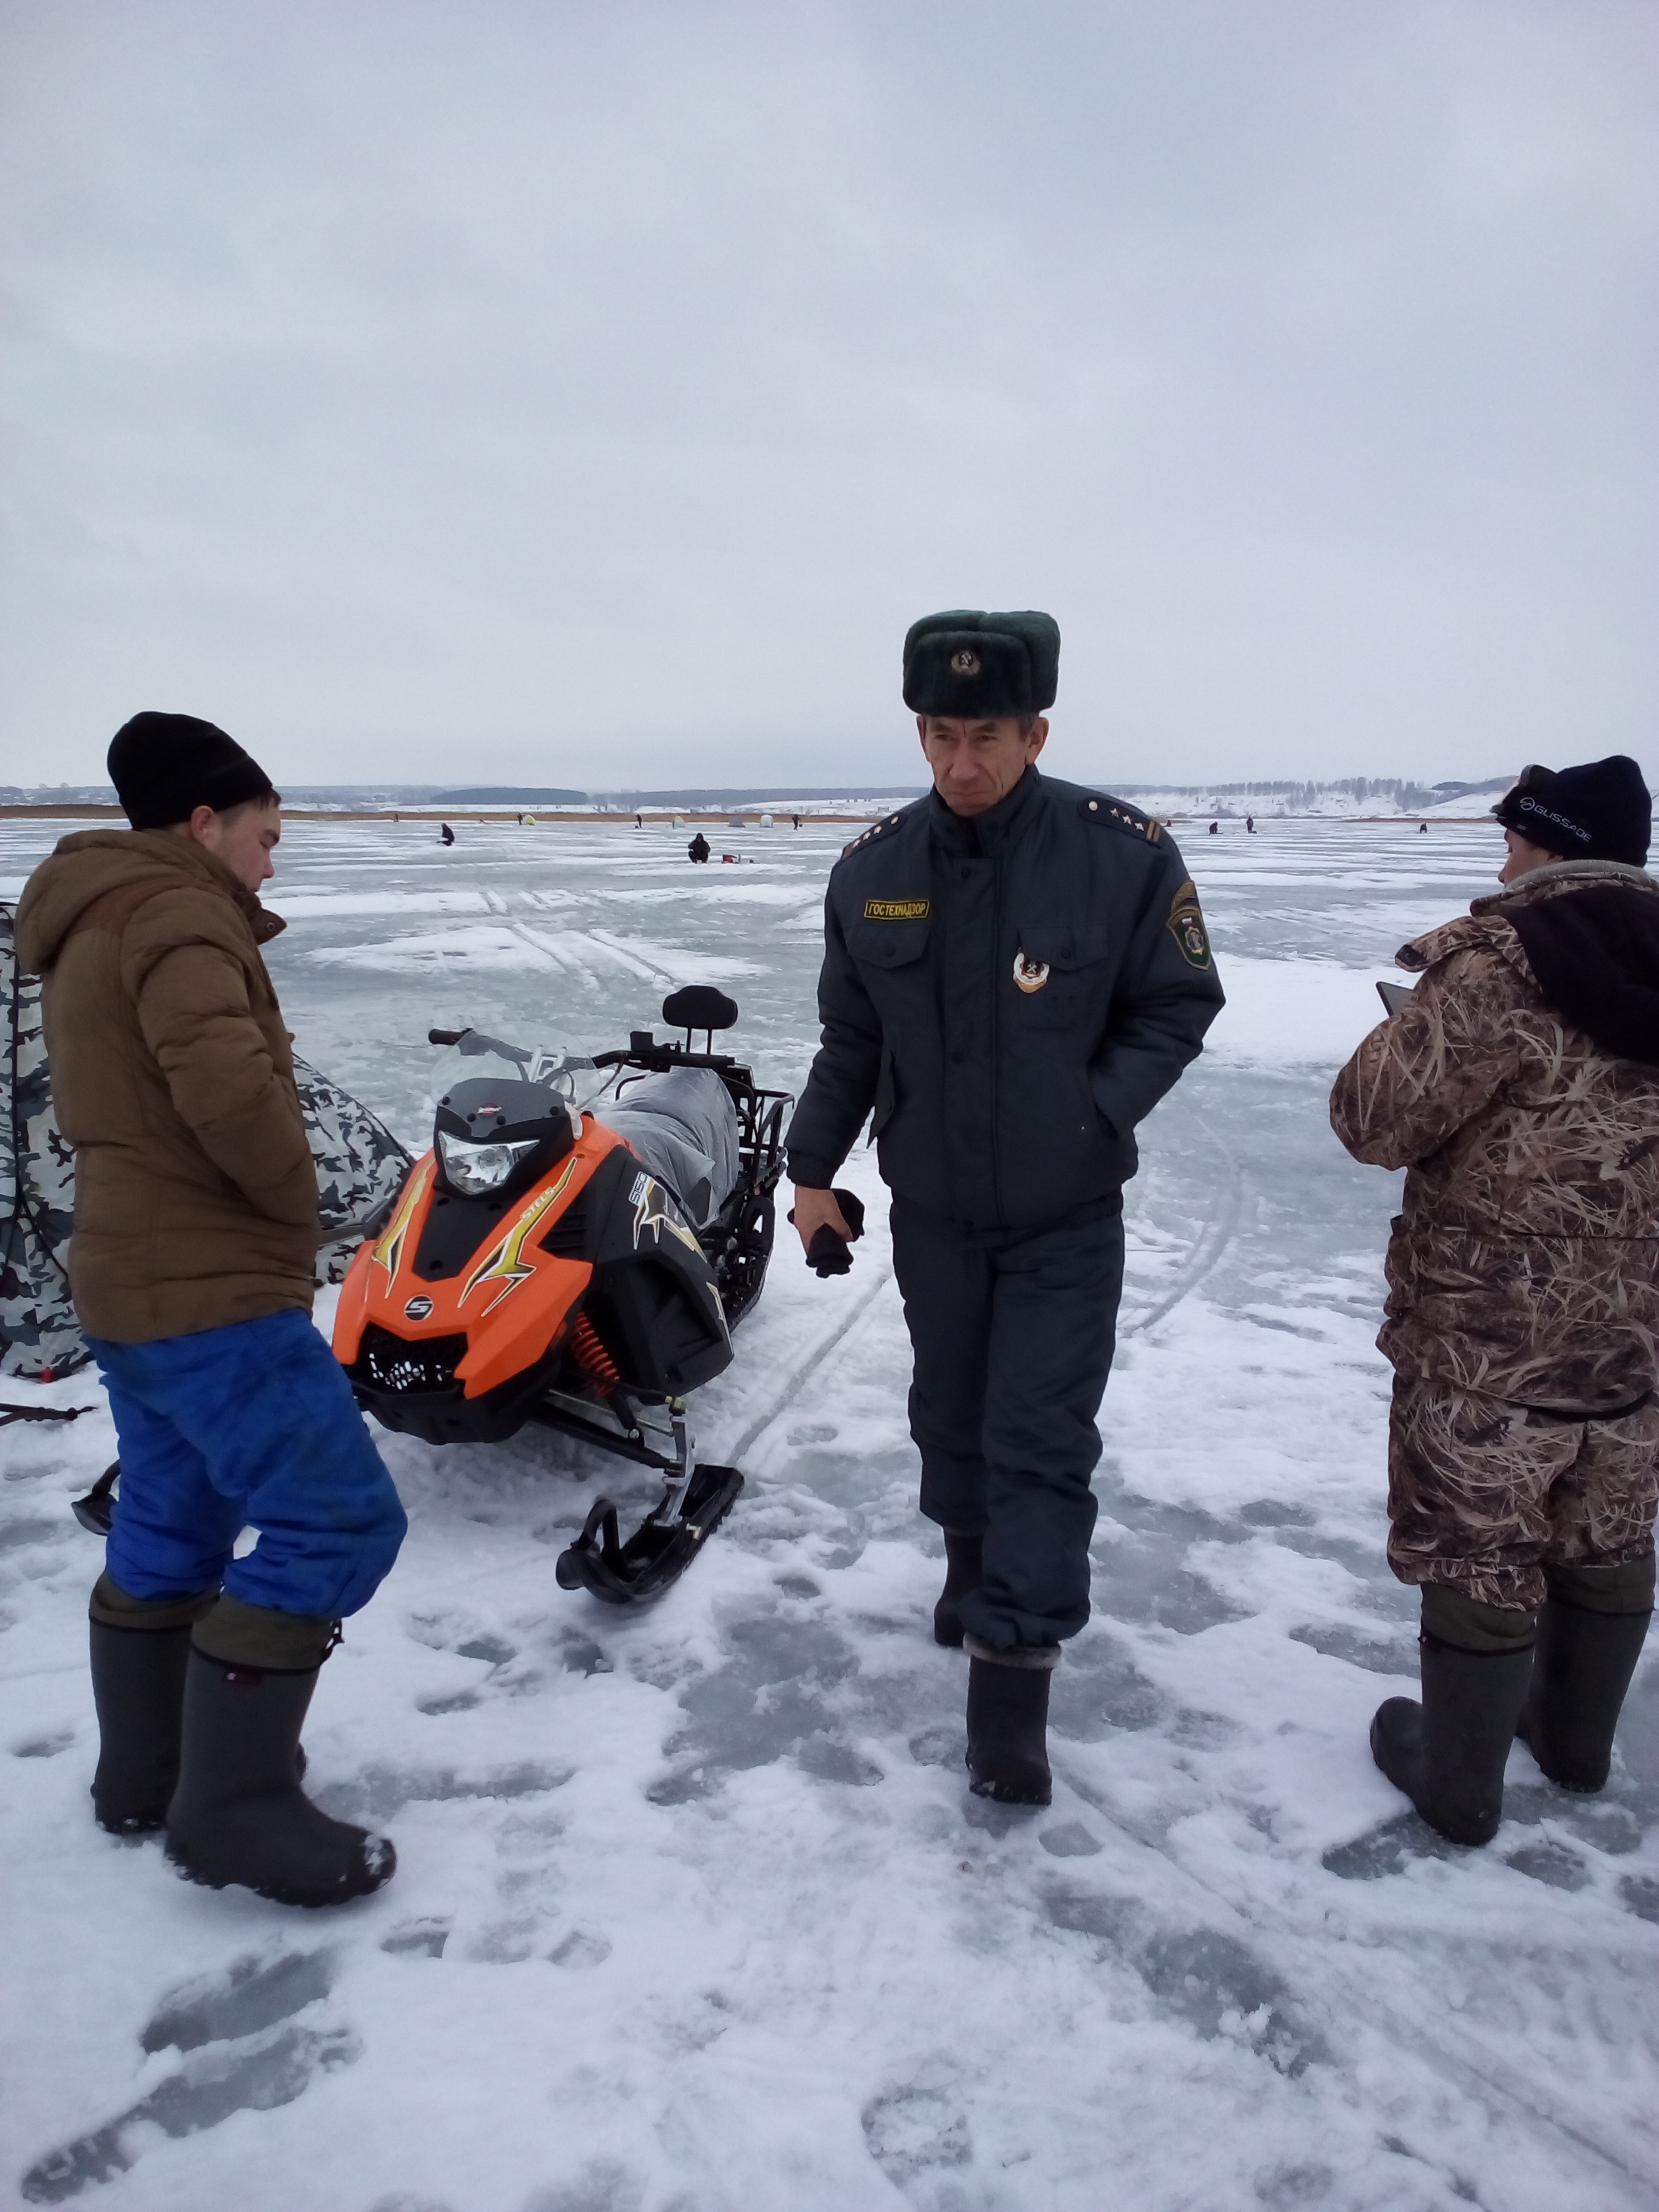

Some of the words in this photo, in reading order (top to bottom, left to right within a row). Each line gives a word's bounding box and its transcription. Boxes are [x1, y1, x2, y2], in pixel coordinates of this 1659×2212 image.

[1534, 805, 1593, 843] GLISSADE
[868, 903, 926, 918] ГОСТЕХНАДЗОР
[522, 1188, 554, 1219] STELS
[630, 1171, 648, 1205] S150
